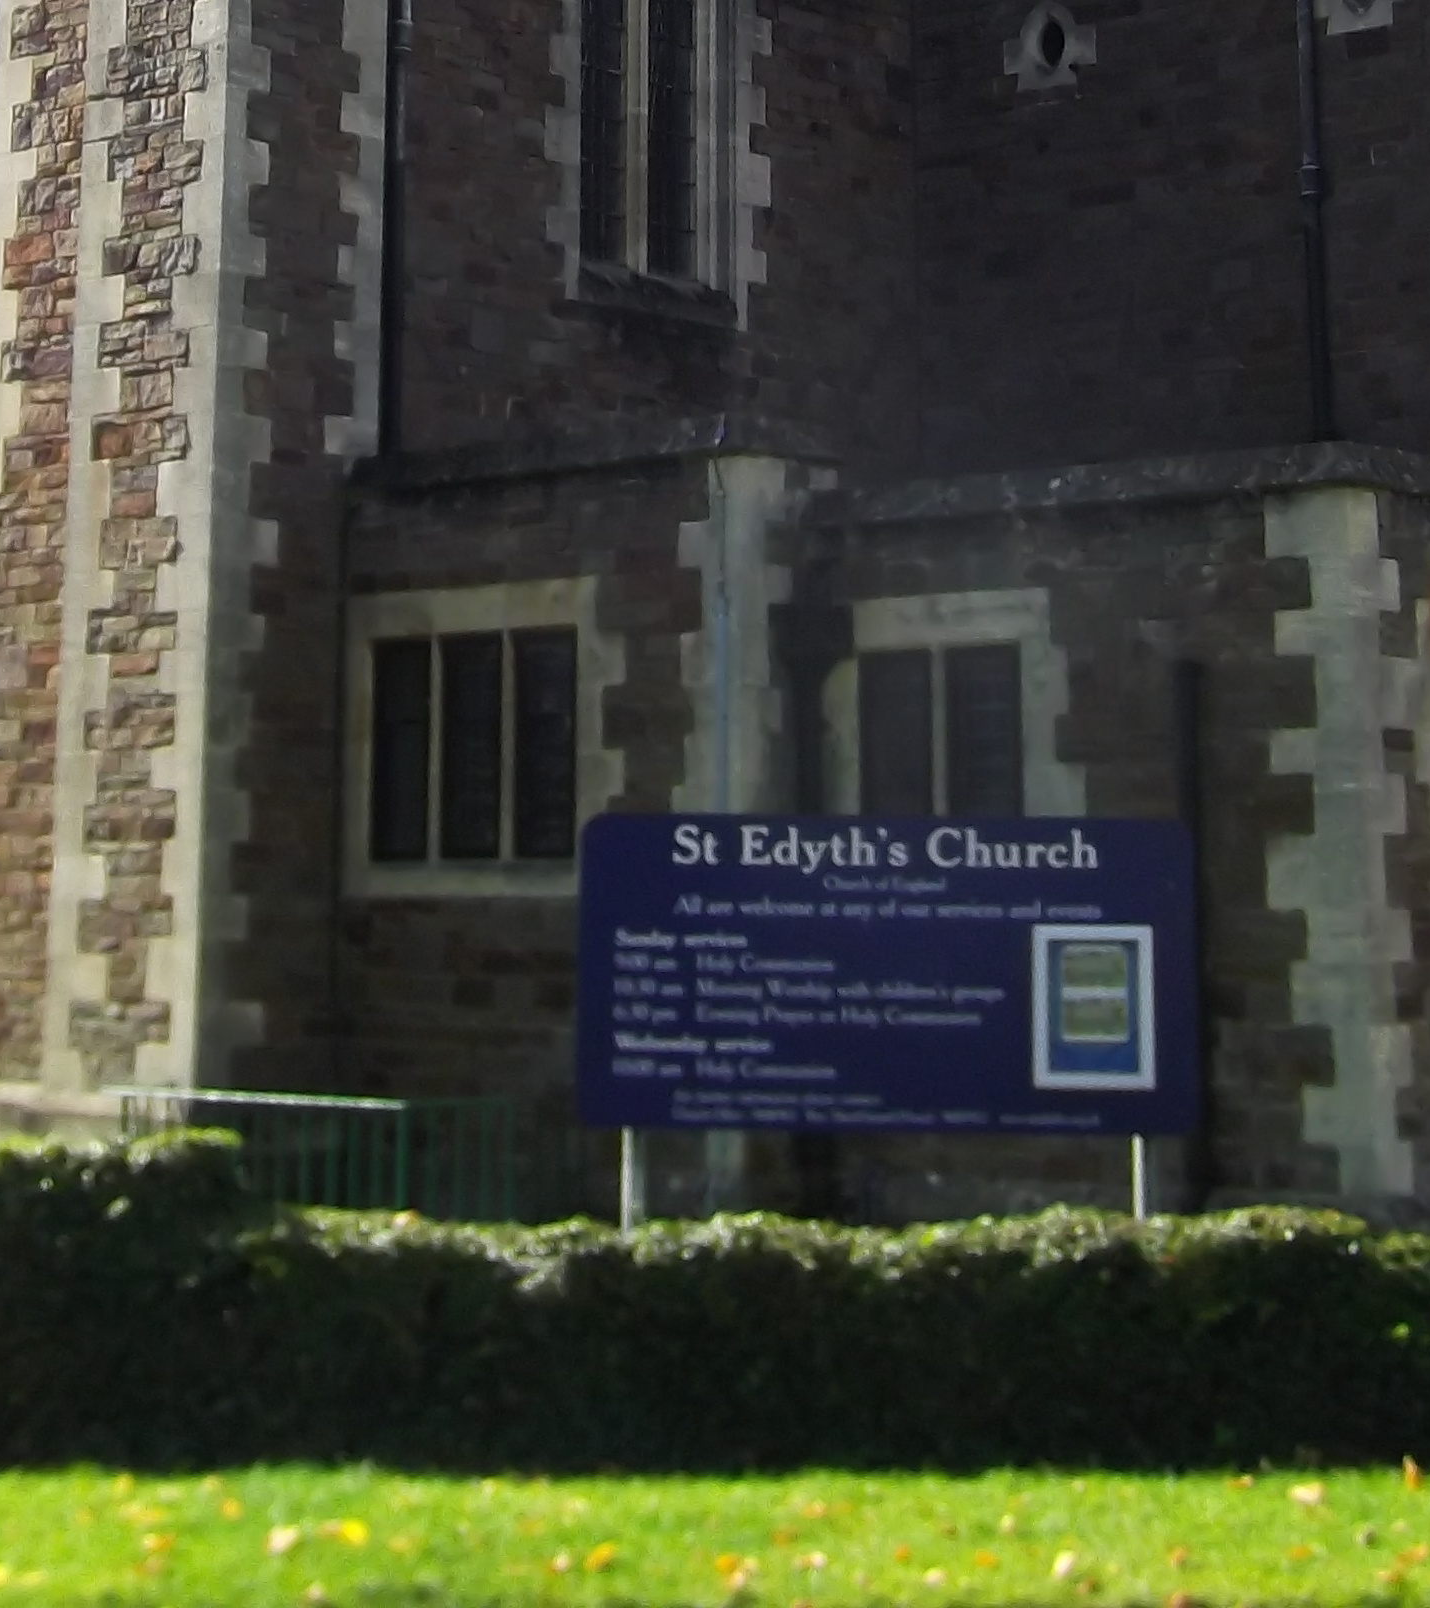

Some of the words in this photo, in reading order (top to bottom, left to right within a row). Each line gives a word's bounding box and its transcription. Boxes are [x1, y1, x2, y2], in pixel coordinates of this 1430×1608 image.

[671, 824, 719, 864] St
[739, 826, 909, 874] Edyth's
[926, 826, 1099, 868] Church
